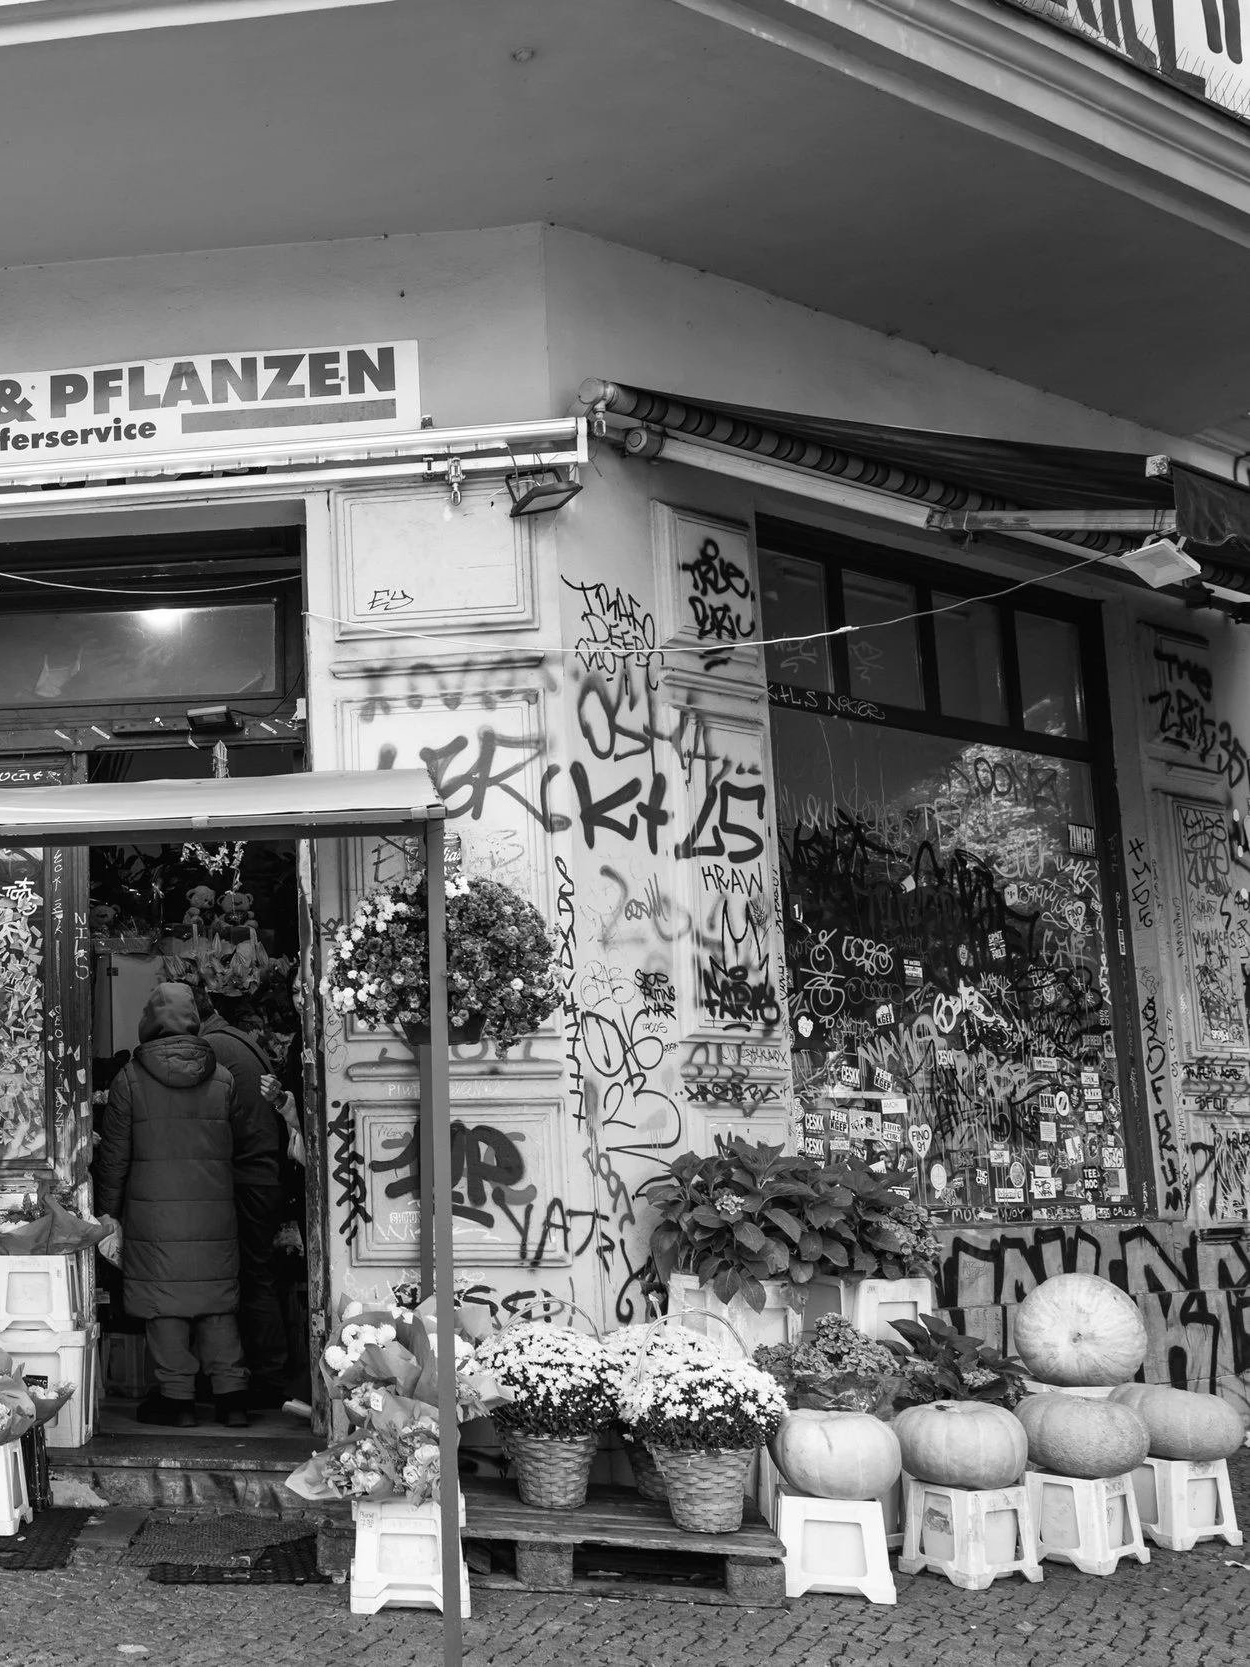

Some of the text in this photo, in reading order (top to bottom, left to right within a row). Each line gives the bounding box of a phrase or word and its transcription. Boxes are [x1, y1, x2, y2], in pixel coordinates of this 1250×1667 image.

[50, 347, 396, 419] PFLANZEN
[1067, 906, 1083, 918] FINO
[1072, 916, 1082, 927] 91
[830, 1110, 848, 1122] PEGK
[830, 1121, 849, 1134] KGEP
[911, 1130, 930, 1141] FINO
[916, 1141, 927, 1153] 91
